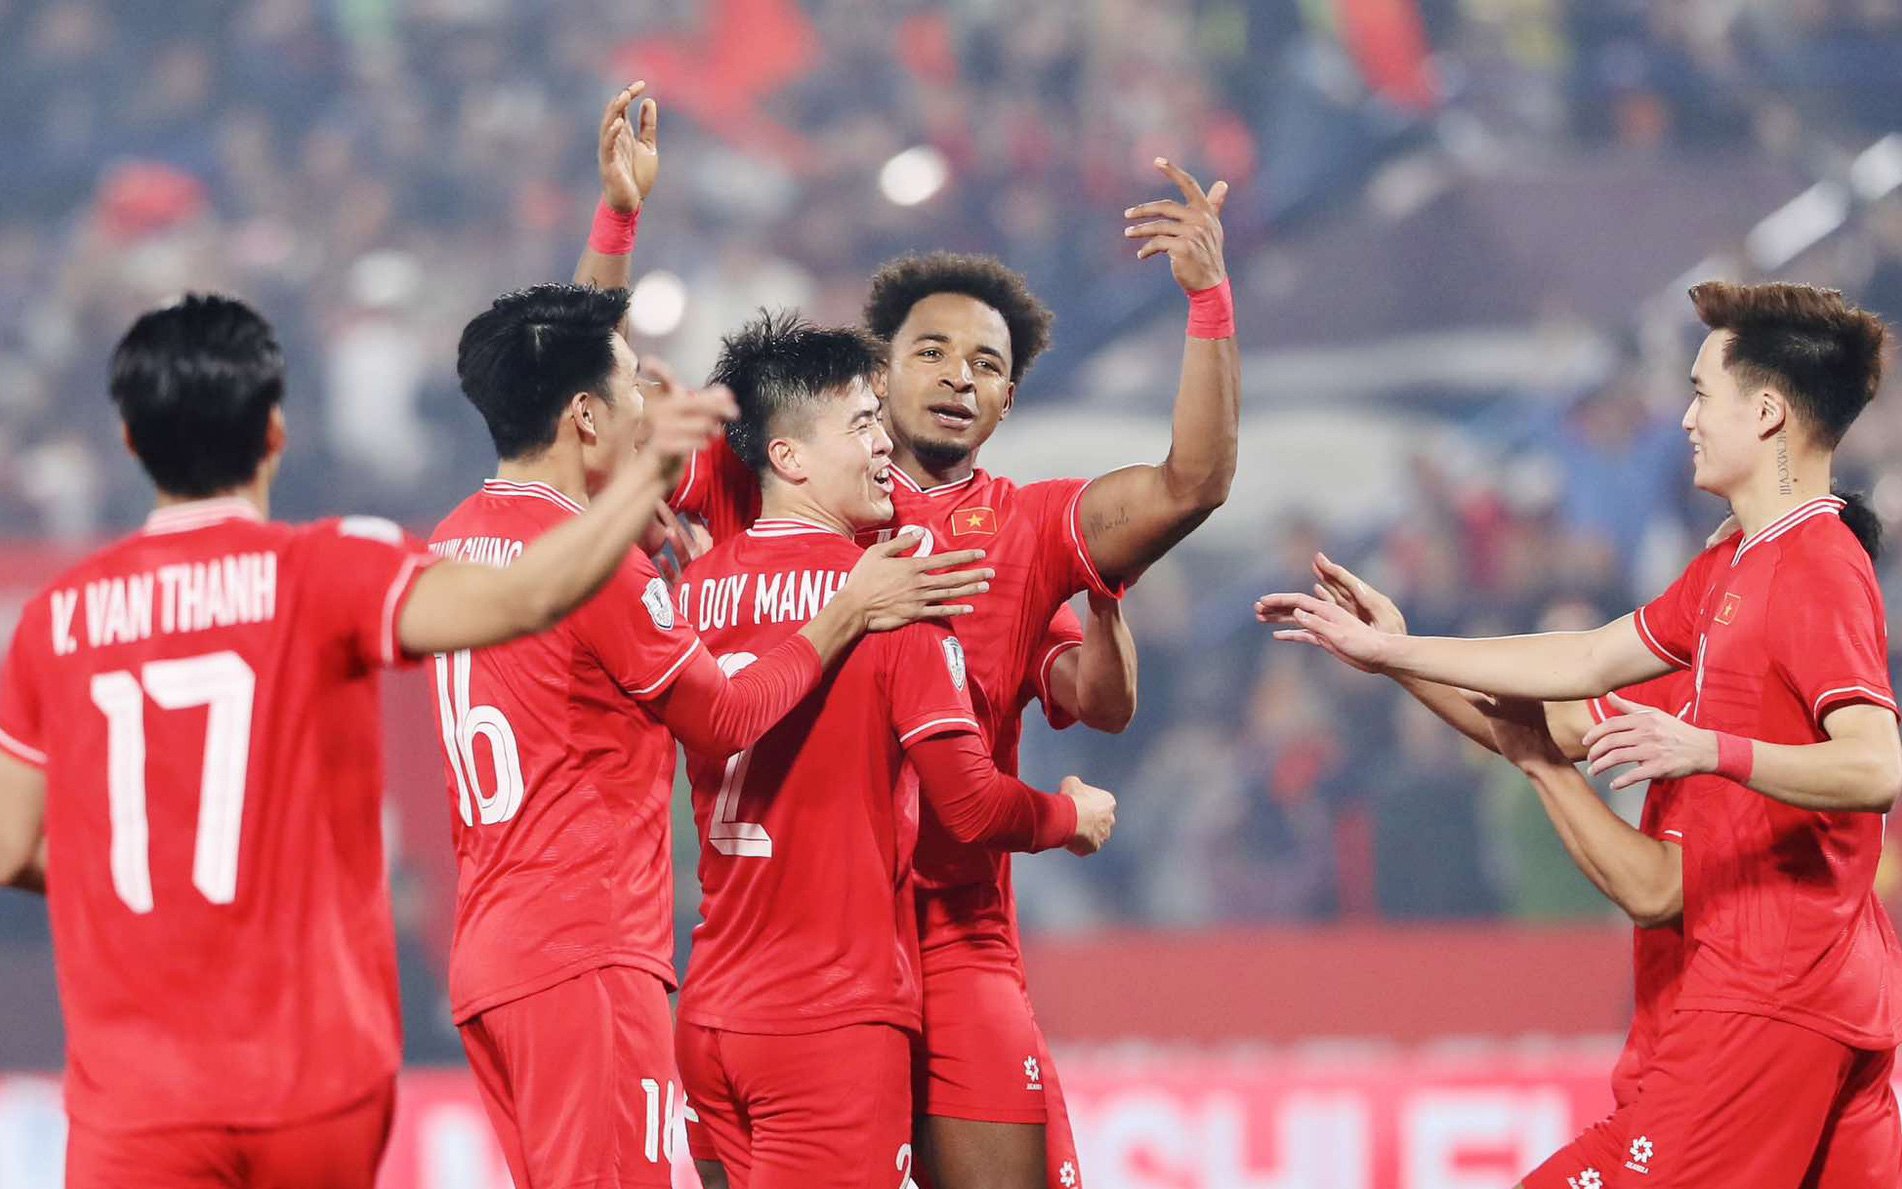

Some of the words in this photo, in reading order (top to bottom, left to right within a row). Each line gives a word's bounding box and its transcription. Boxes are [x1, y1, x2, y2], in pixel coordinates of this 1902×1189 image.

[50, 588, 78, 656] V.
[85, 571, 154, 648] VAN
[157, 550, 278, 634] THANH
[699, 573, 749, 632] DUY
[753, 569, 848, 625] MANH
[90, 650, 256, 914] 17
[434, 649, 525, 828] 16
